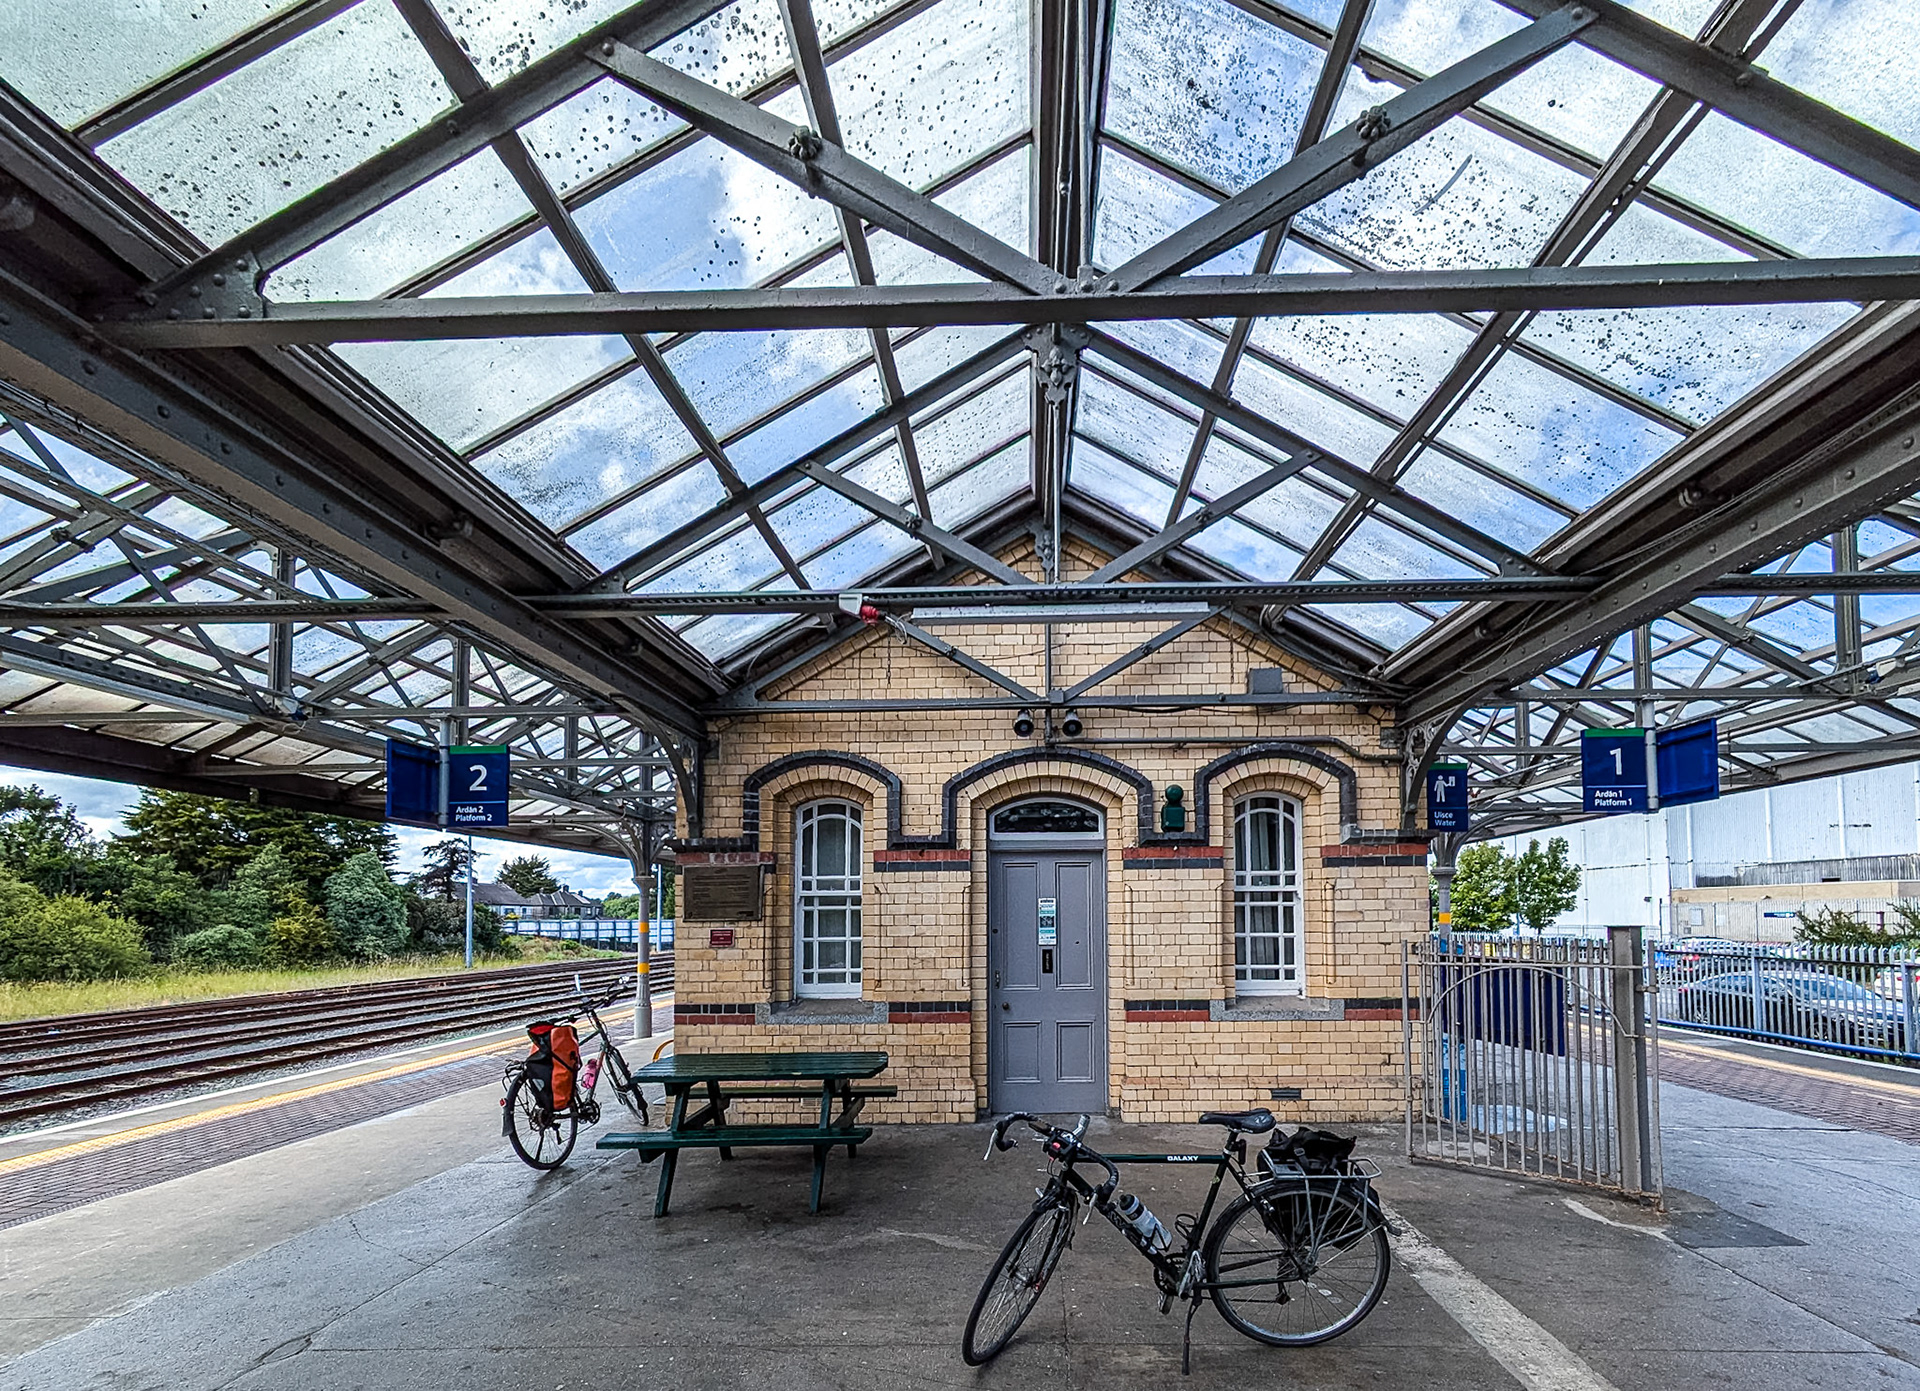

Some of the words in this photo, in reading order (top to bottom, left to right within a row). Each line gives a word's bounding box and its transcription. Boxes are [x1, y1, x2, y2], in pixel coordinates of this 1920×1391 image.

[1609, 747, 1623, 776] 1
[469, 764, 488, 792] 2
[1618, 790, 1623, 798] 1
[1595, 798, 1627, 806] Platform
[1627, 798, 1632, 806] 1
[455, 814, 486, 822] Platform
[486, 814, 492, 822] 2
[1434, 811, 1453, 819] Uisce
